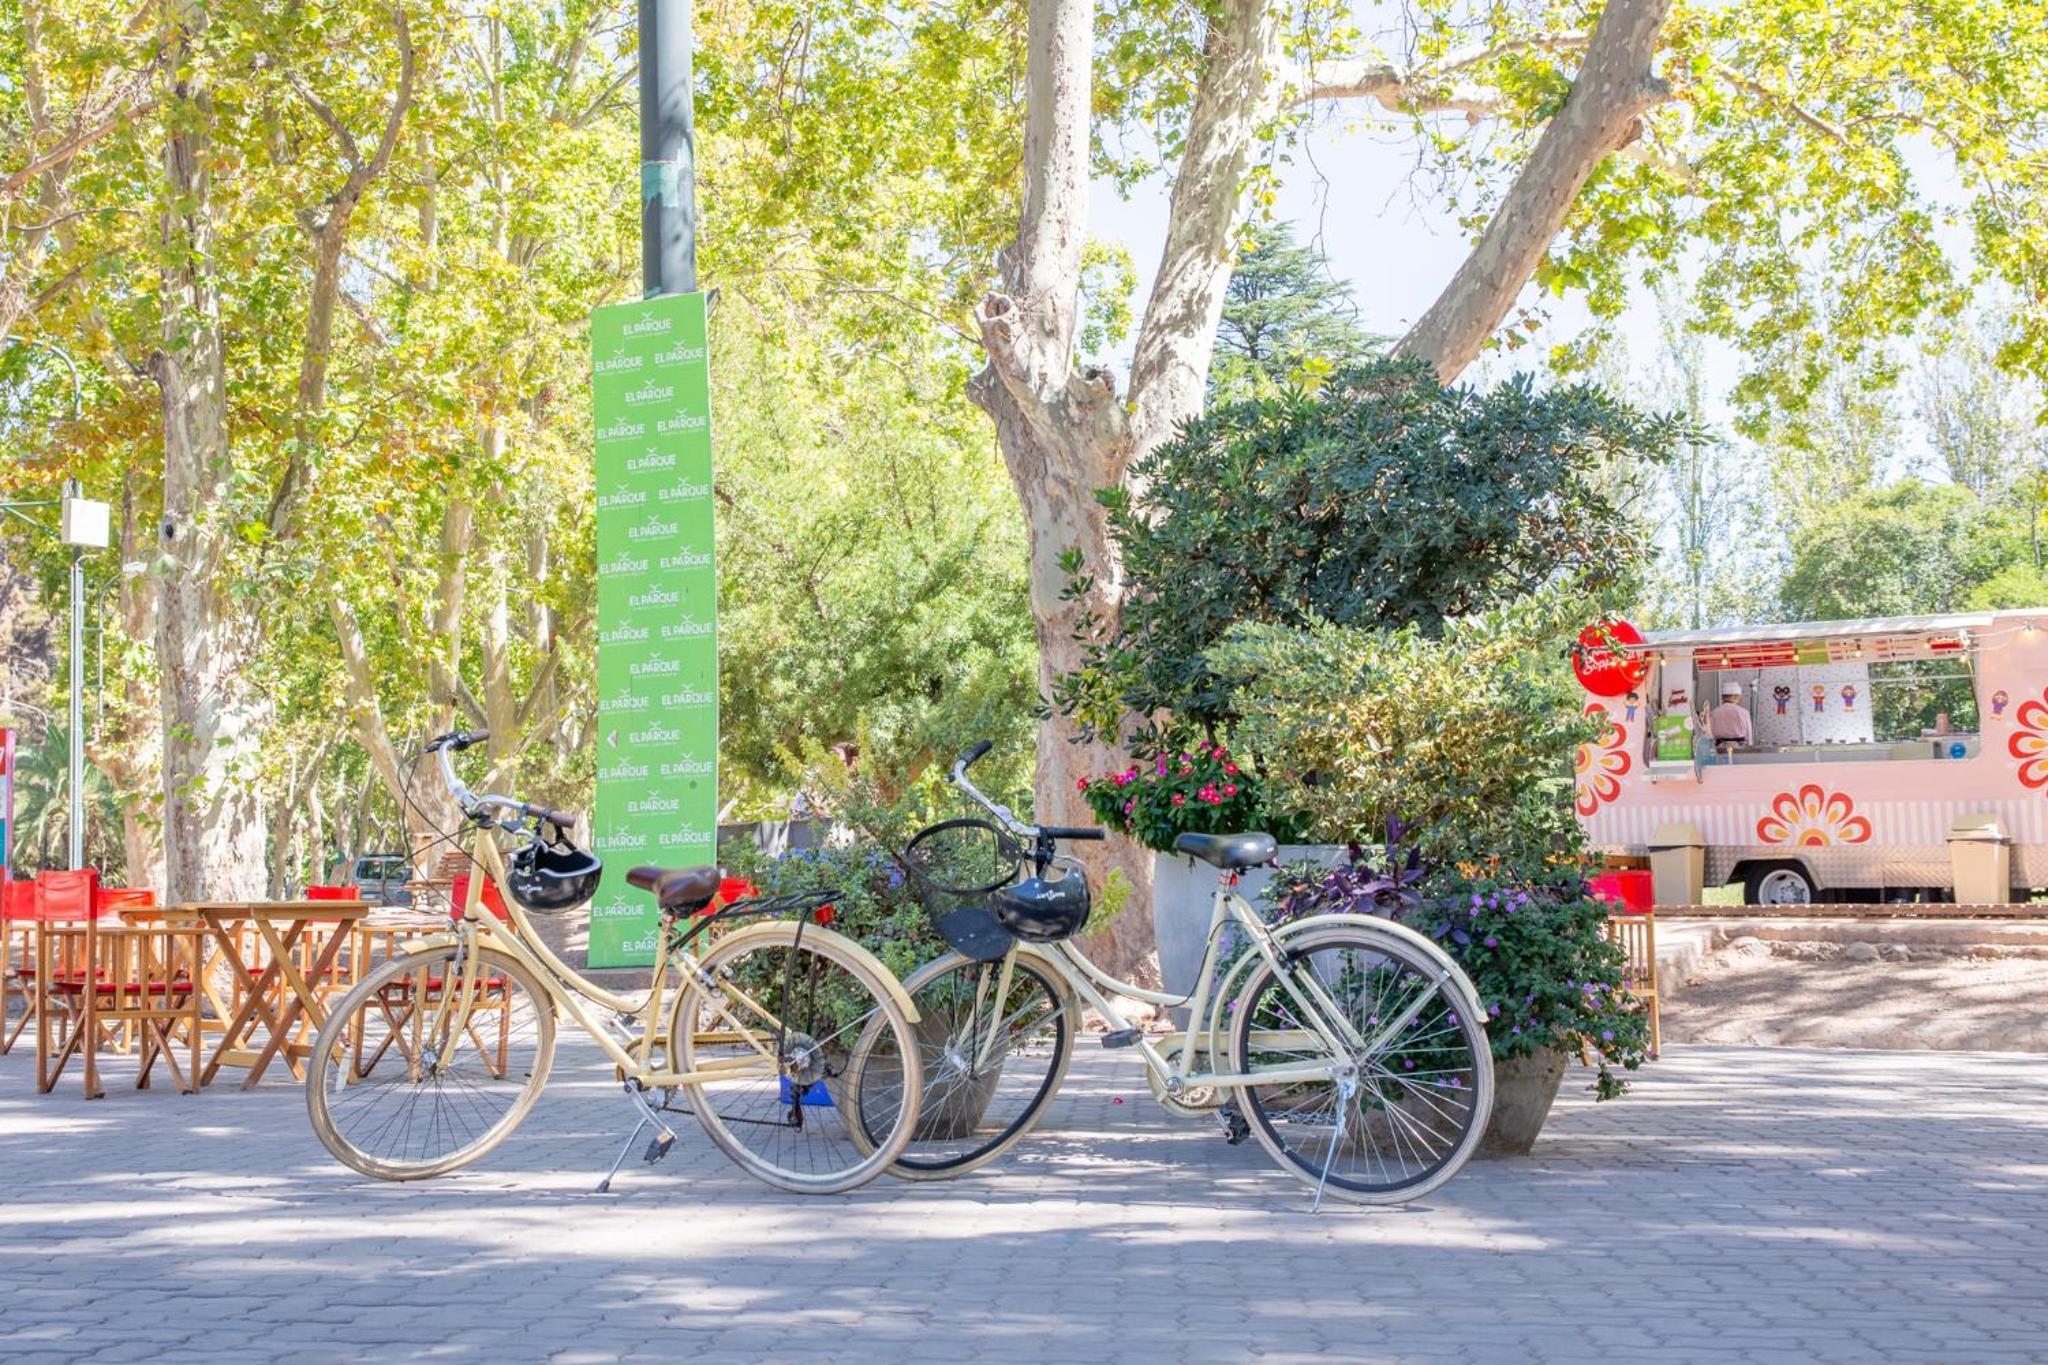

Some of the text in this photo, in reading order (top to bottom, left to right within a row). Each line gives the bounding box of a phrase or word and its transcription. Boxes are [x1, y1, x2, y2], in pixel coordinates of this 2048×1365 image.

[624, 319, 672, 335] EL PARQUE
[655, 347, 703, 364] EL PARQUE
[596, 356, 643, 371] EL PARQUE
[626, 386, 673, 402] EL PARQUE
[658, 416, 706, 432] EL PARQUE
[598, 424, 644, 439] EL PARQUE
[627, 454, 675, 470] EL PARQUE
[659, 484, 708, 499] EL PARQUE
[600, 492, 646, 506] EL PARQUE
[629, 523, 678, 537] EL PARQUE
[600, 560, 648, 574] EL PARQUE
[660, 553, 710, 568] EL PARQUE
[630, 592, 678, 606] EL PARQUE
[600, 628, 648, 642] EL PARQUE
[661, 623, 712, 636] EL PARQUE
[630, 660, 679, 674] EL PARQUE
[600, 696, 648, 710] EL PARQUE
[662, 692, 712, 705] EL PARQUE
[630, 730, 680, 743] EL PARQUE
[600, 766, 648, 778] EL PARQUE
[660, 762, 712, 774] EL PARQUE
[628, 800, 679, 812] EL PARQUE
[597, 835, 646, 848] EL PARQUE
[660, 832, 710, 844] EL PARQUE
[594, 904, 644, 916] EL PARQUE
[623, 940, 656, 952] EL PAR
